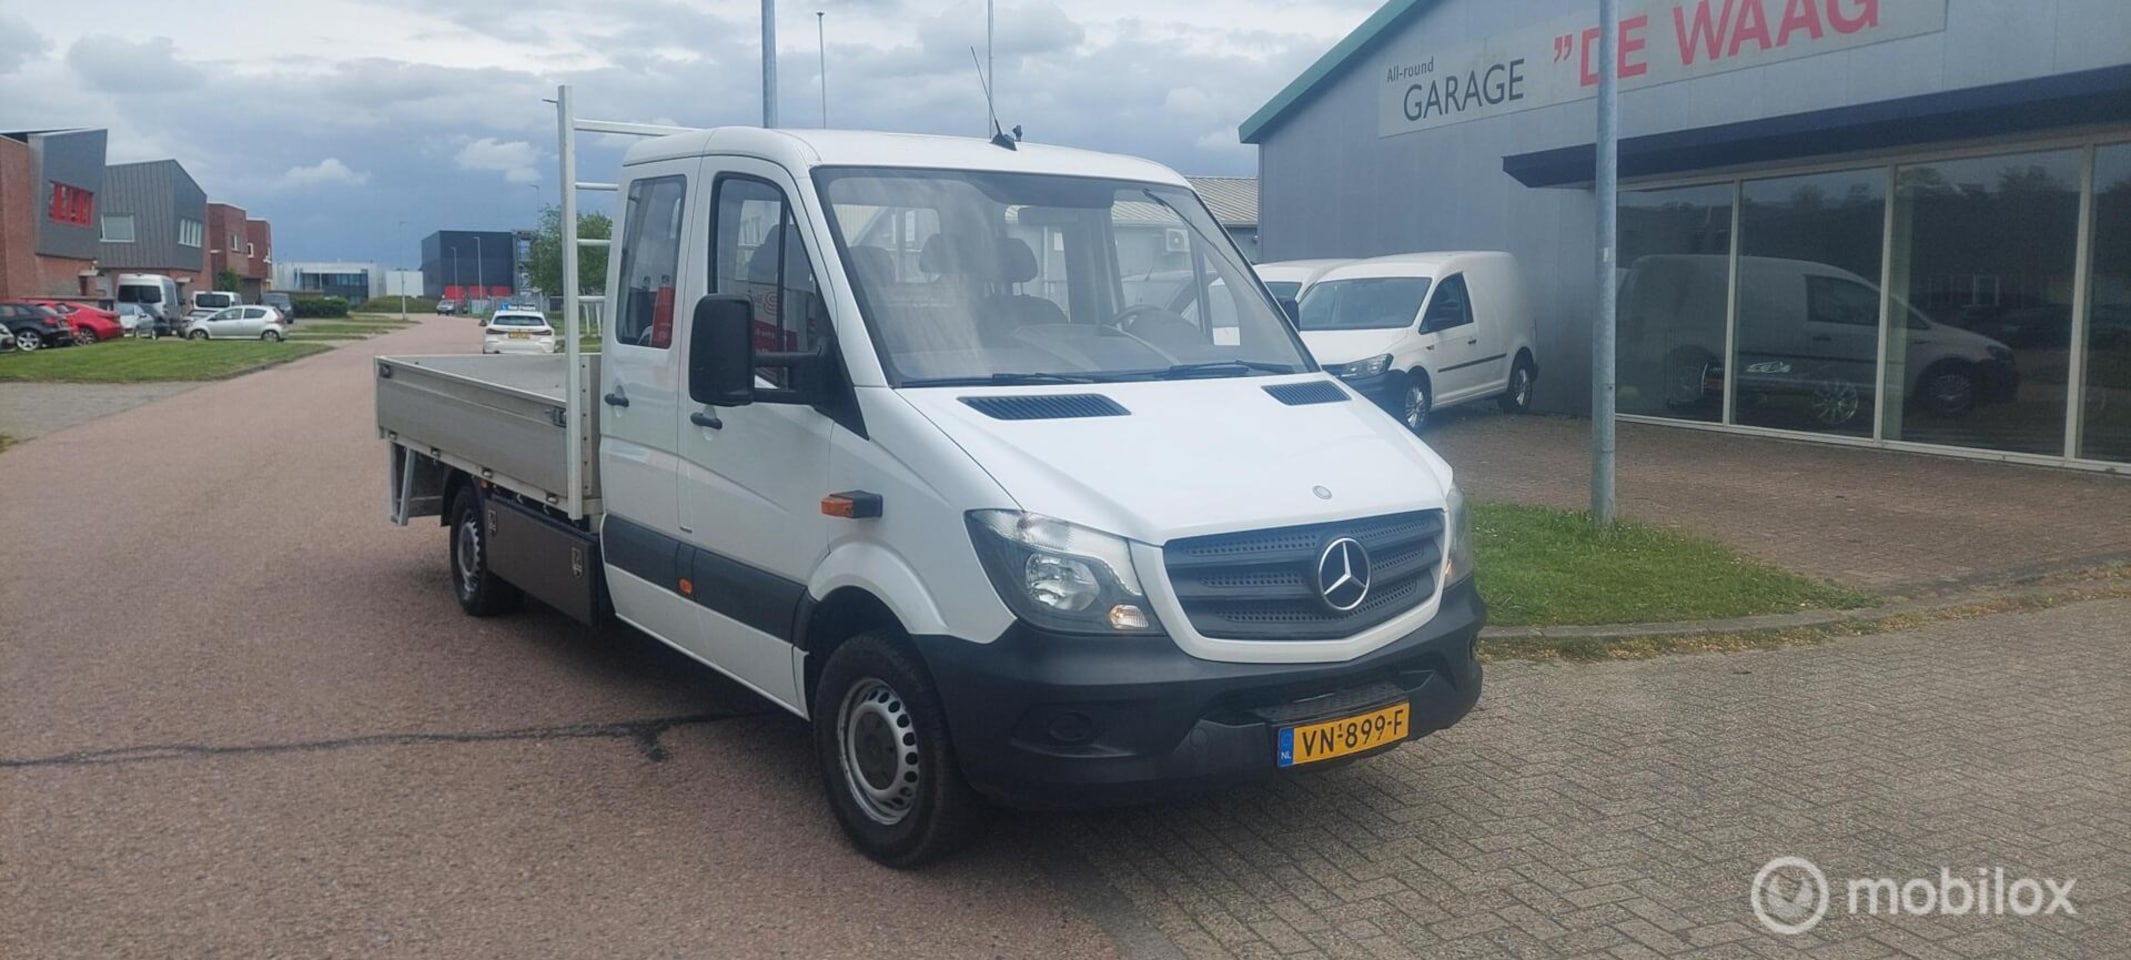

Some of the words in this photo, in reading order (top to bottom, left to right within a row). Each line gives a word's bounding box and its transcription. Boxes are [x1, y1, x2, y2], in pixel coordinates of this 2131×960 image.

[1387, 56, 1434, 83] All-round
[1404, 58, 1525, 121] GARAGE
[1281, 751, 1292, 760] NL
